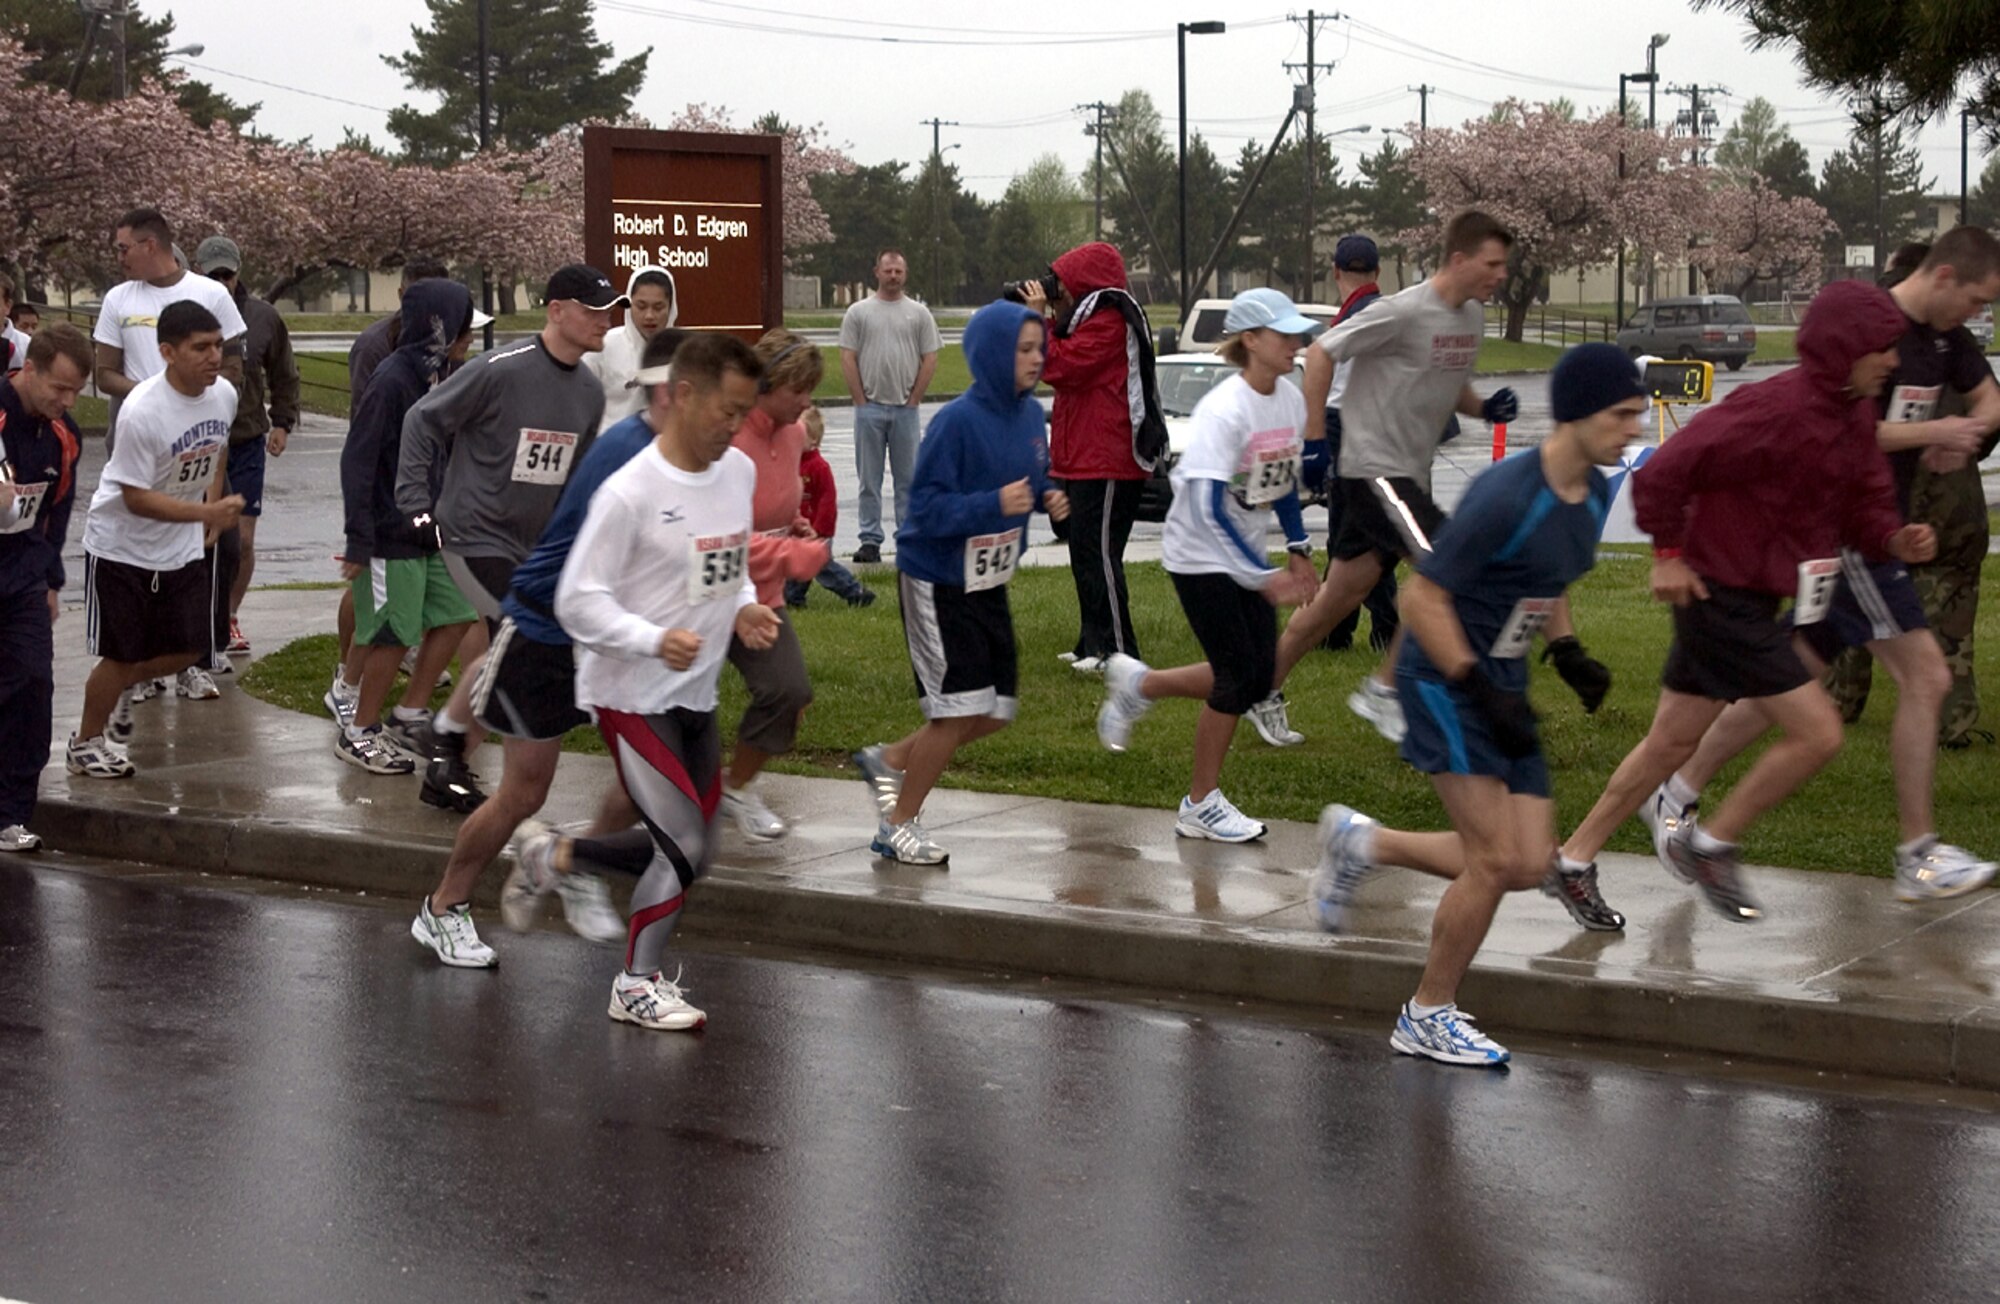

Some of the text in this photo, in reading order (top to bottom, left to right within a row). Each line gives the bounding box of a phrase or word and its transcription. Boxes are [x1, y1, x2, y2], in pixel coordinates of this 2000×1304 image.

[613, 213, 748, 241] Robert D. Edgren
[614, 245, 709, 269] High School
[178, 456, 212, 483] 573
[526, 443, 564, 472] 544
[975, 544, 1011, 576] 542
